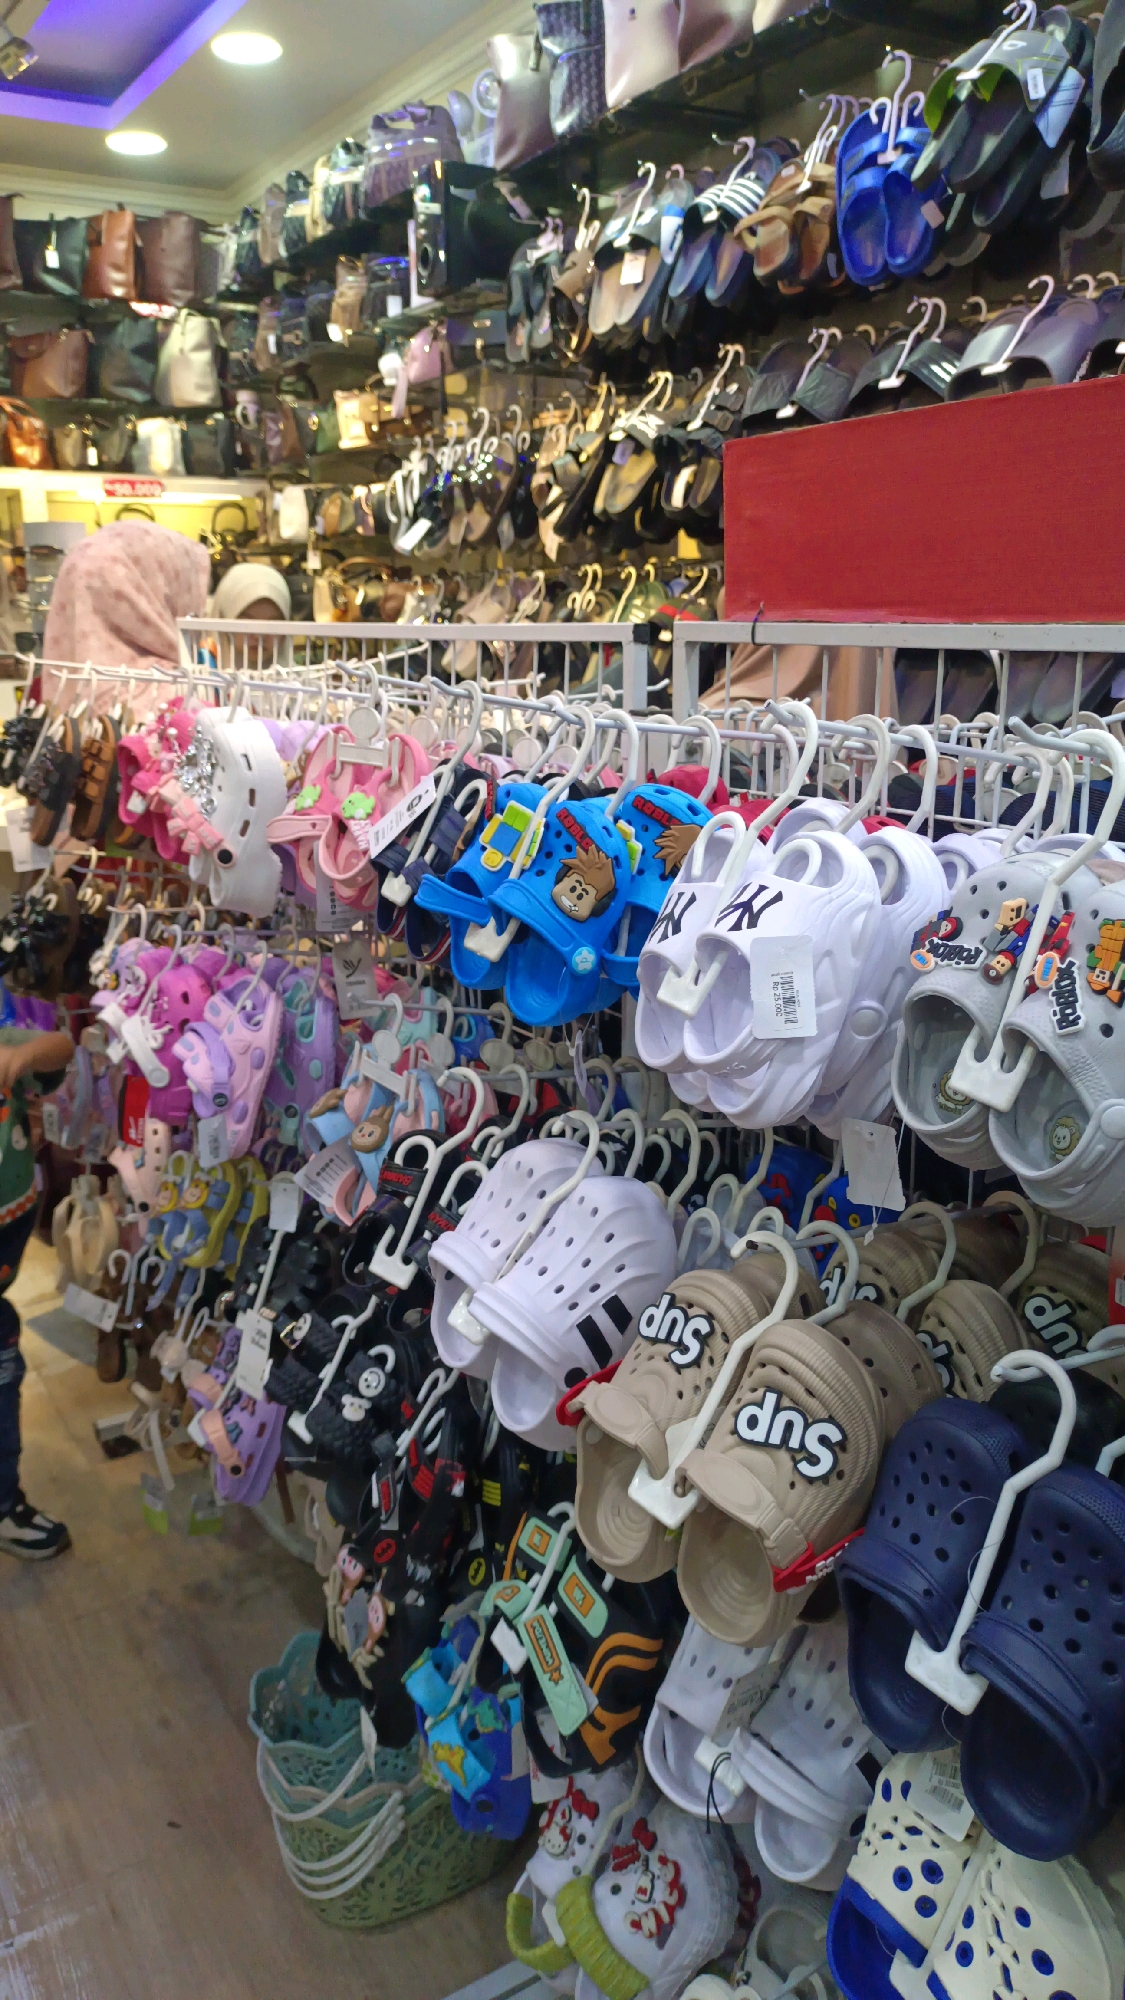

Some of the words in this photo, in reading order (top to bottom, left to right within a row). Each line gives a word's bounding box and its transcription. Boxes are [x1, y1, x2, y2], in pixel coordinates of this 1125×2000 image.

[556, 807, 594, 850] ROBLO
[632, 796, 683, 827] ROBL
[734, 1390, 845, 1479] dns
